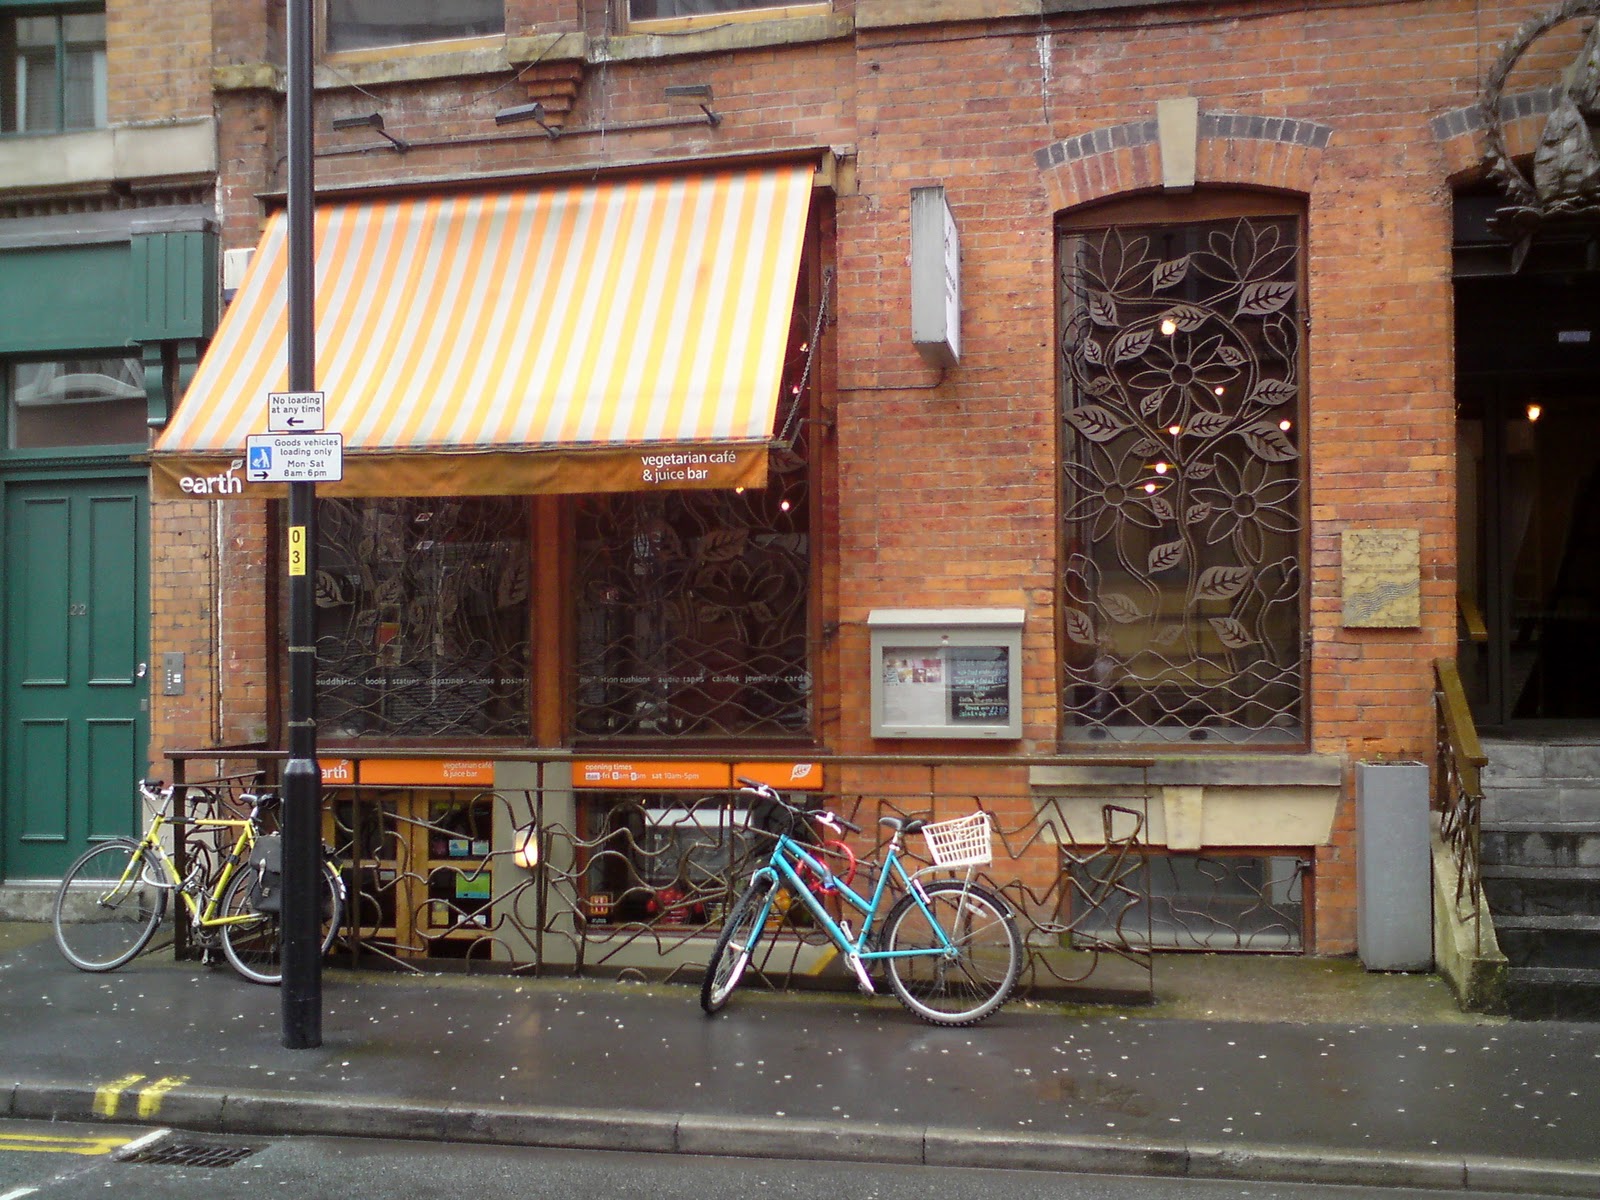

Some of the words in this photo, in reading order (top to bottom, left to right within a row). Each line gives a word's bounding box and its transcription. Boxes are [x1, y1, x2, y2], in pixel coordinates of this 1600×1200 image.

[272, 397, 285, 405] No
[288, 396, 320, 405] loading
[271, 406, 280, 414] at
[283, 407, 299, 415] any
[301, 405, 321, 413] time
[274, 439, 301, 447] Goods
[304, 438, 339, 446] vehicles
[280, 448, 311, 457] loading
[314, 448, 332, 457] only
[641, 451, 707, 468] vegetarian
[709, 450, 736, 464] café
[642, 469, 653, 481] &
[654, 468, 685, 483] juice
[687, 467, 708, 479] bar
[179, 469, 242, 494] earth
[70, 604, 86, 615] 22
[365, 677, 387, 686] books
[321, 763, 347, 779] arth
[585, 763, 612, 772] opening
